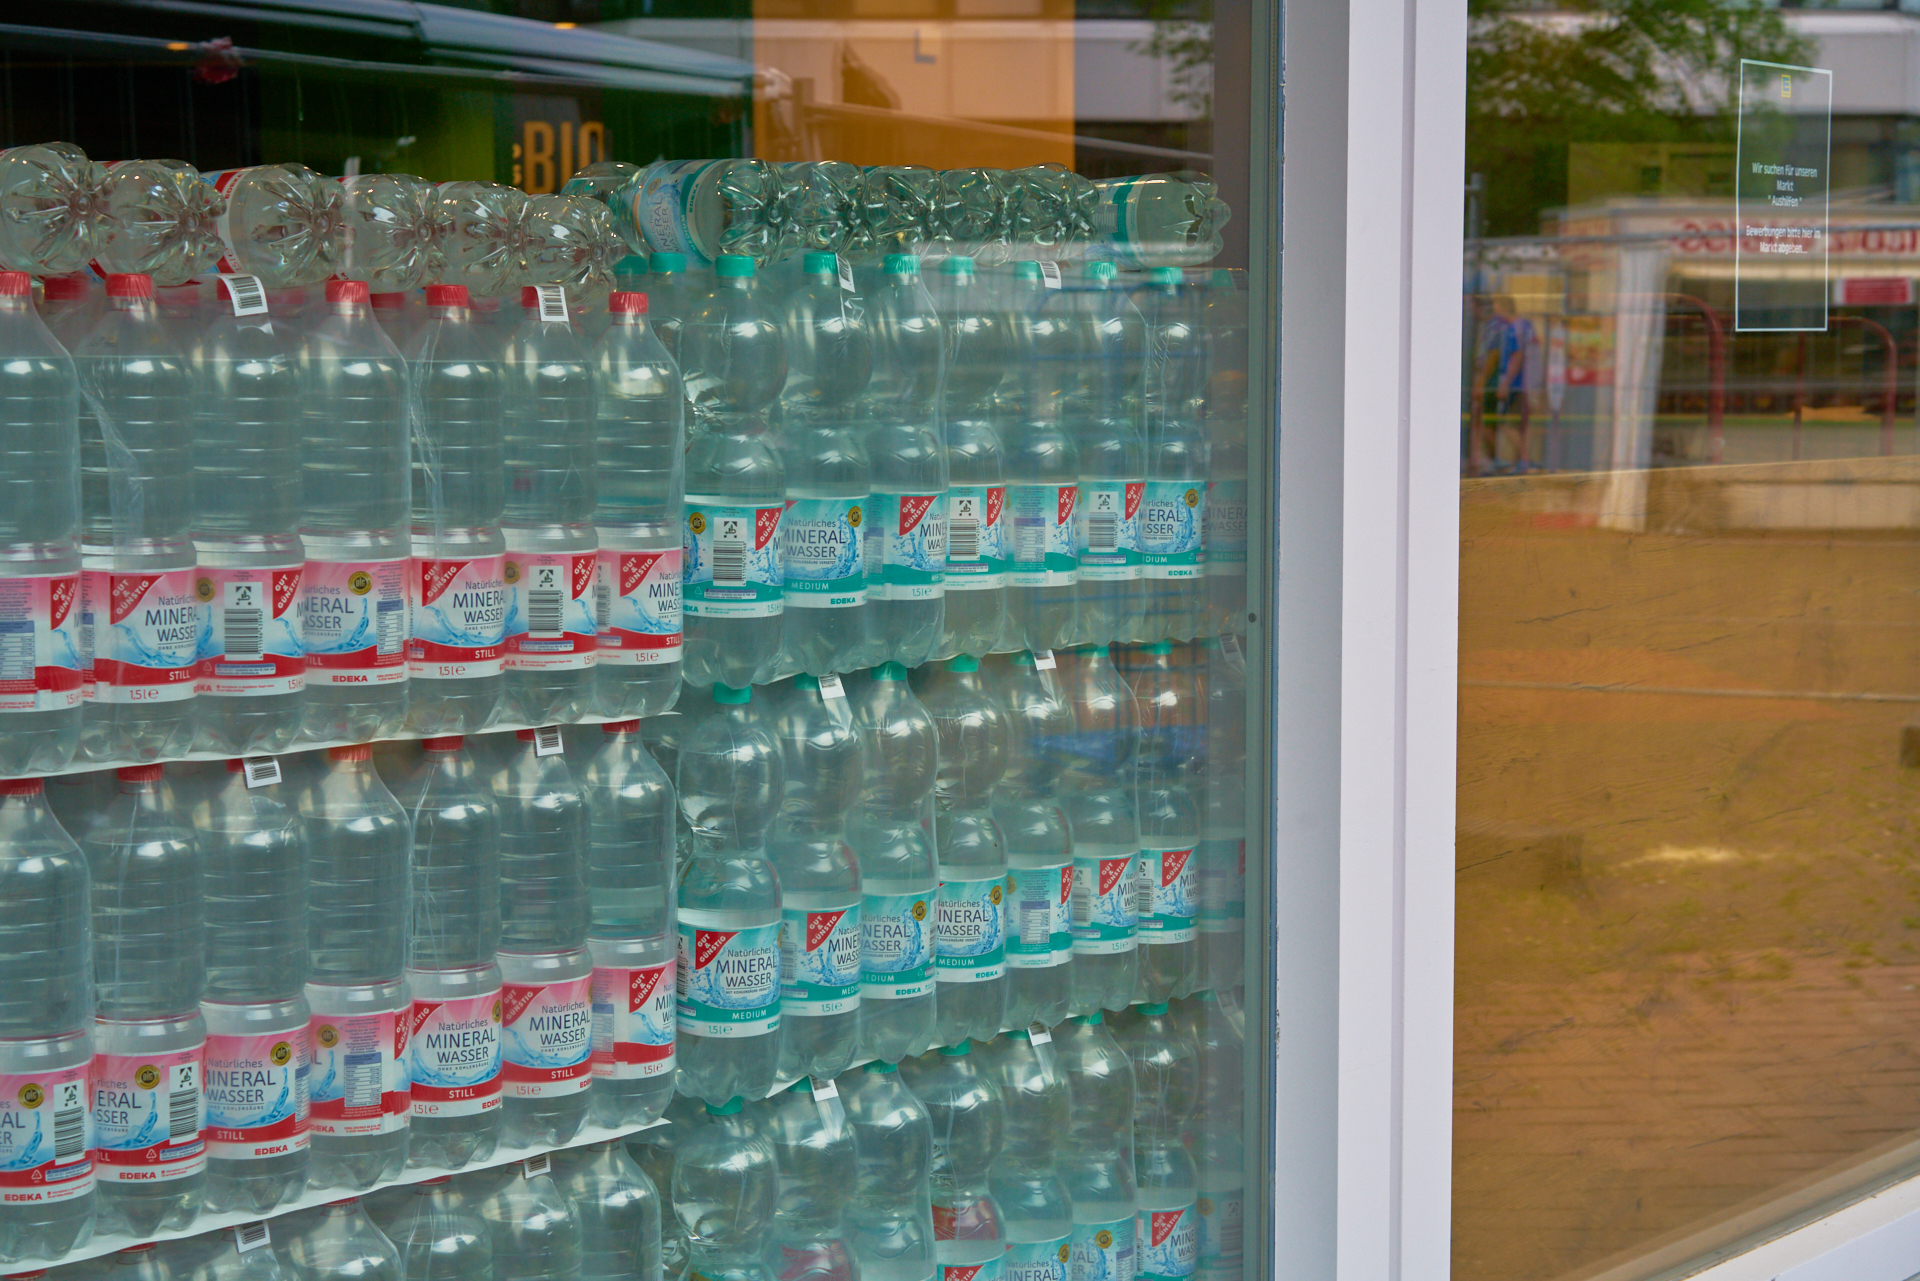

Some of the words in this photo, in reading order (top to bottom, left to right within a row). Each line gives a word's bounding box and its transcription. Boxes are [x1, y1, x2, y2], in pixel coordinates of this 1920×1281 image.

[1752, 162, 1763, 173] Wir
[1764, 164, 1784, 175] suchen
[1795, 167, 1817, 177] unseren
[1777, 180, 1794, 191] Markt
[1746, 225, 1786, 238] Bewerbungen
[1787, 227, 1801, 237] bitte
[1802, 228, 1813, 238] hier
[1760, 242, 1778, 252] Markt
[989, 491, 997, 504] GUT
[1060, 490, 1069, 503] GUT
[1127, 486, 1136, 499] GUT
[902, 499, 915, 513] GUT
[758, 511, 769, 526] GUT
[904, 500, 929, 528] GÜNSTIG
[786, 545, 837, 558] WASSER
[574, 558, 585, 574] GUT
[623, 557, 637, 572] GUT
[424, 565, 439, 581] GUT
[625, 558, 653, 588] GÜNSTIG
[113, 579, 129, 596] GUT
[275, 574, 288, 591] GUT
[792, 582, 829, 590] MEDIUM
[53, 583, 65, 600] GUT
[116, 580, 149, 614] GÜNSTIG
[277, 574, 300, 608] GÜNSTIG
[475, 649, 495, 659] STILL
[169, 670, 190, 680] STILL
[1164, 854, 1176, 867] GUT
[1102, 862, 1113, 875] GUT
[810, 916, 823, 930] GUT
[938, 909, 989, 923] INERAL
[812, 915, 837, 944] GÜNSTIG
[697, 933, 710, 947] GUT
[700, 935, 726, 962] GÜNSTIG
[728, 946, 772, 958] Natürliches
[716, 955, 777, 974] MINERAL
[939, 958, 974, 966] MEDIUM
[726, 972, 772, 988] WASSER
[976, 970, 998, 978] EDEKA
[632, 974, 645, 989] GUT
[634, 973, 659, 1004] GÜNSTIG
[504, 990, 516, 1004] GUT
[896, 987, 921, 995] EDEKA
[506, 991, 534, 1020] GÜNSTIG
[542, 1001, 585, 1014] Natürliches
[530, 1009, 590, 1031] MINERAL
[732, 1010, 766, 1020] MEDIUM
[438, 1019, 488, 1031] Natürliches
[426, 1027, 496, 1049] MINERAL
[540, 1028, 585, 1045] WASSER
[437, 1046, 489, 1064] WASSER
[208, 1058, 262, 1068] Natürliches
[551, 1069, 574, 1079] STILL
[207, 1089, 264, 1103] WASSER
[449, 1089, 475, 1098] STILL
[217, 1130, 244, 1140] STILL
[255, 1145, 288, 1156] EDEKA
[4, 1193, 42, 1201] EDEKA
[1154, 1215, 1166, 1227] GUT
[1006, 1260, 1049, 1268] Natürliches
